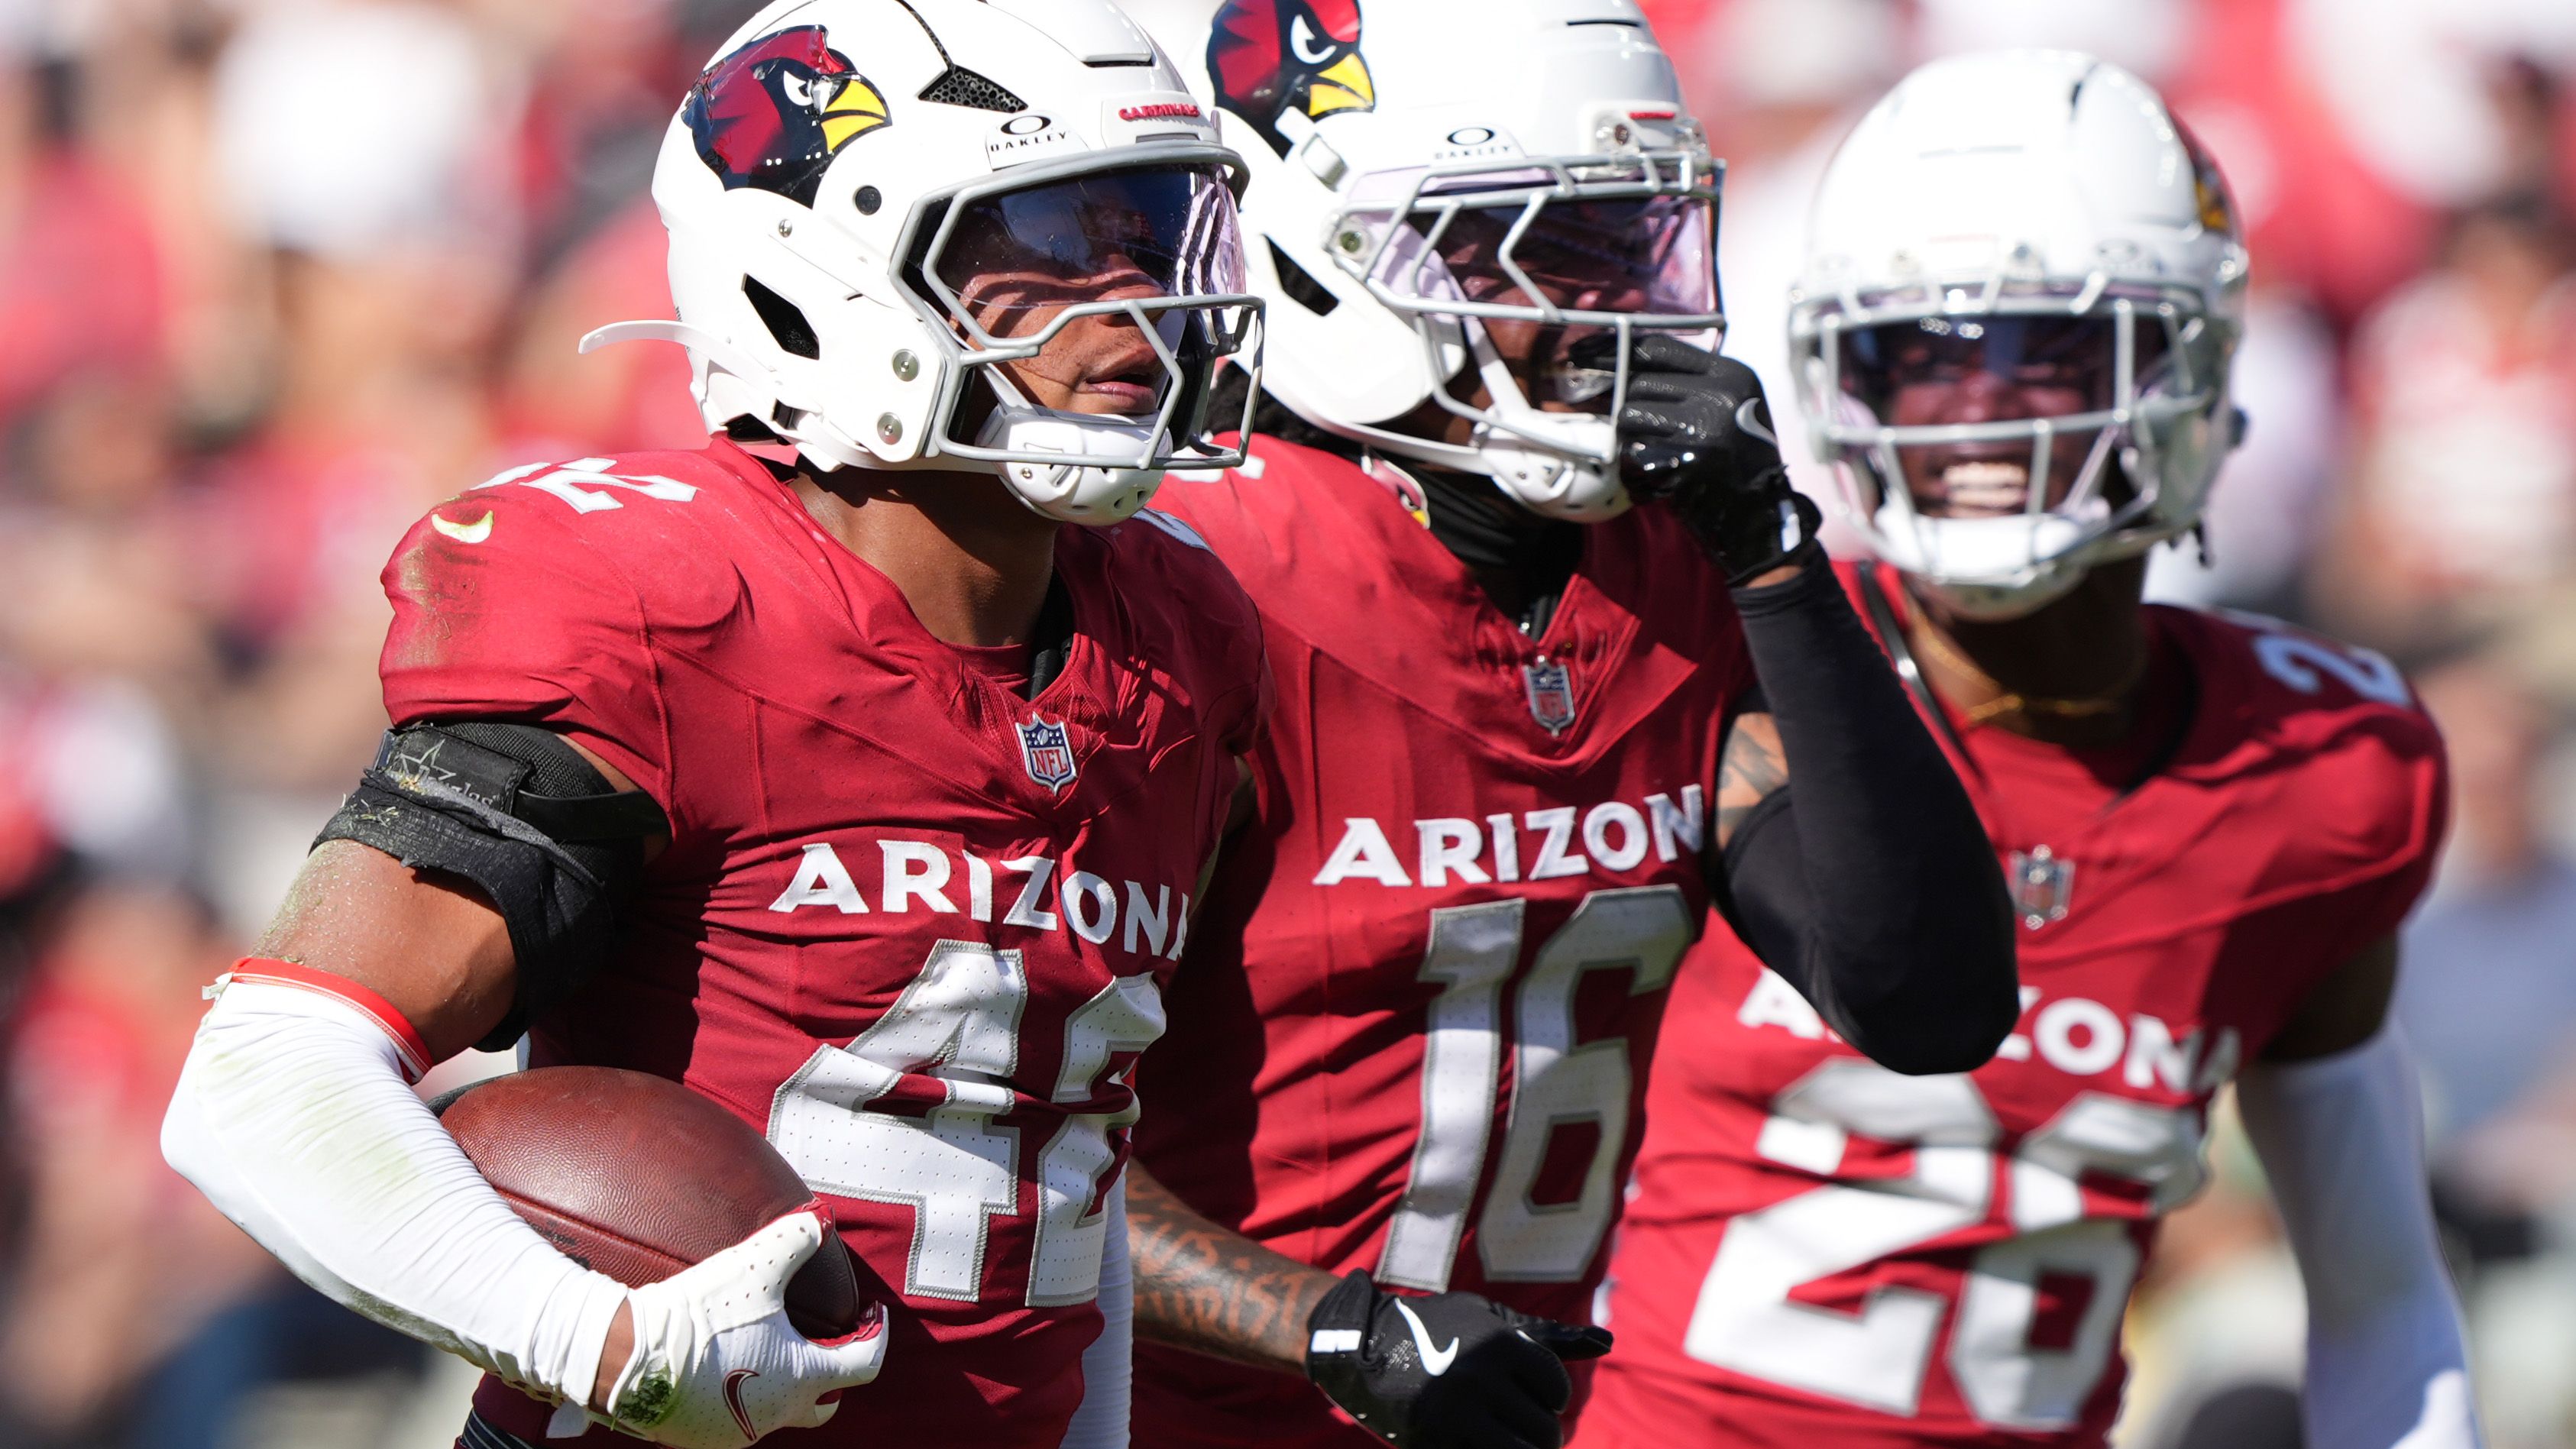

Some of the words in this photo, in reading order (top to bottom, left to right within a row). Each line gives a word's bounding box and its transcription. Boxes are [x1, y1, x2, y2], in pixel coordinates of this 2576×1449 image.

[990, 131, 1066, 152] OAKLEY
[1032, 749, 1069, 778] NFL
[1314, 784, 1703, 888] ARIZON
[1377, 884, 1694, 1292] 16
[1684, 1056, 2212, 1432] 26
